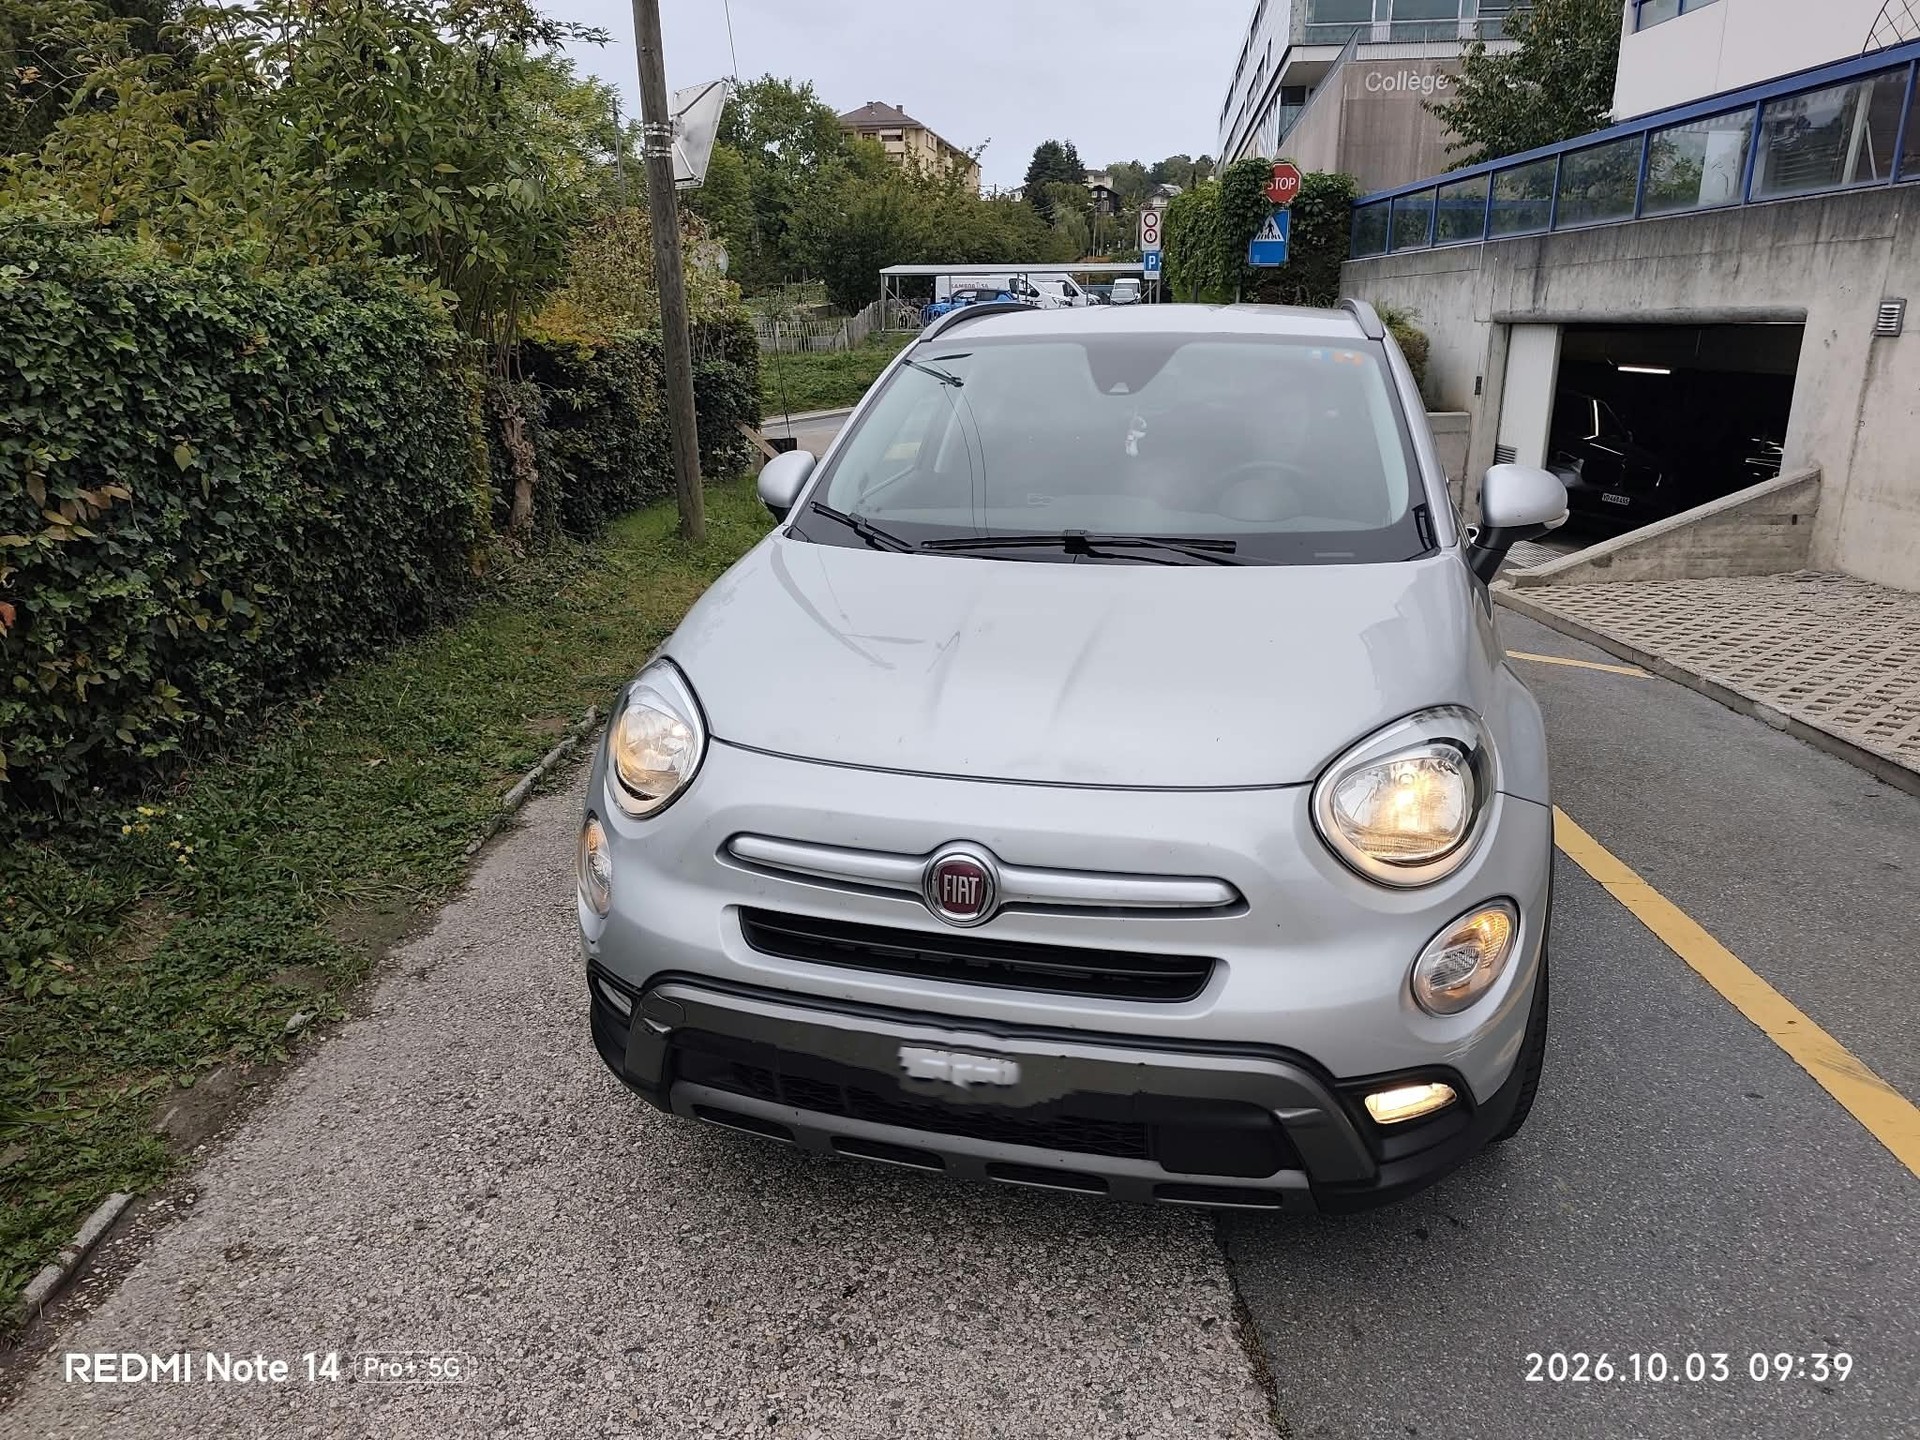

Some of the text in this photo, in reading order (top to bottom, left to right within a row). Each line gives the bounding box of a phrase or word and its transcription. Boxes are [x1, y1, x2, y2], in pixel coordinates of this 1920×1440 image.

[1365, 70, 1449, 95] Collège
[1149, 255, 1156, 270] P
[943, 874, 980, 905] FIAT
